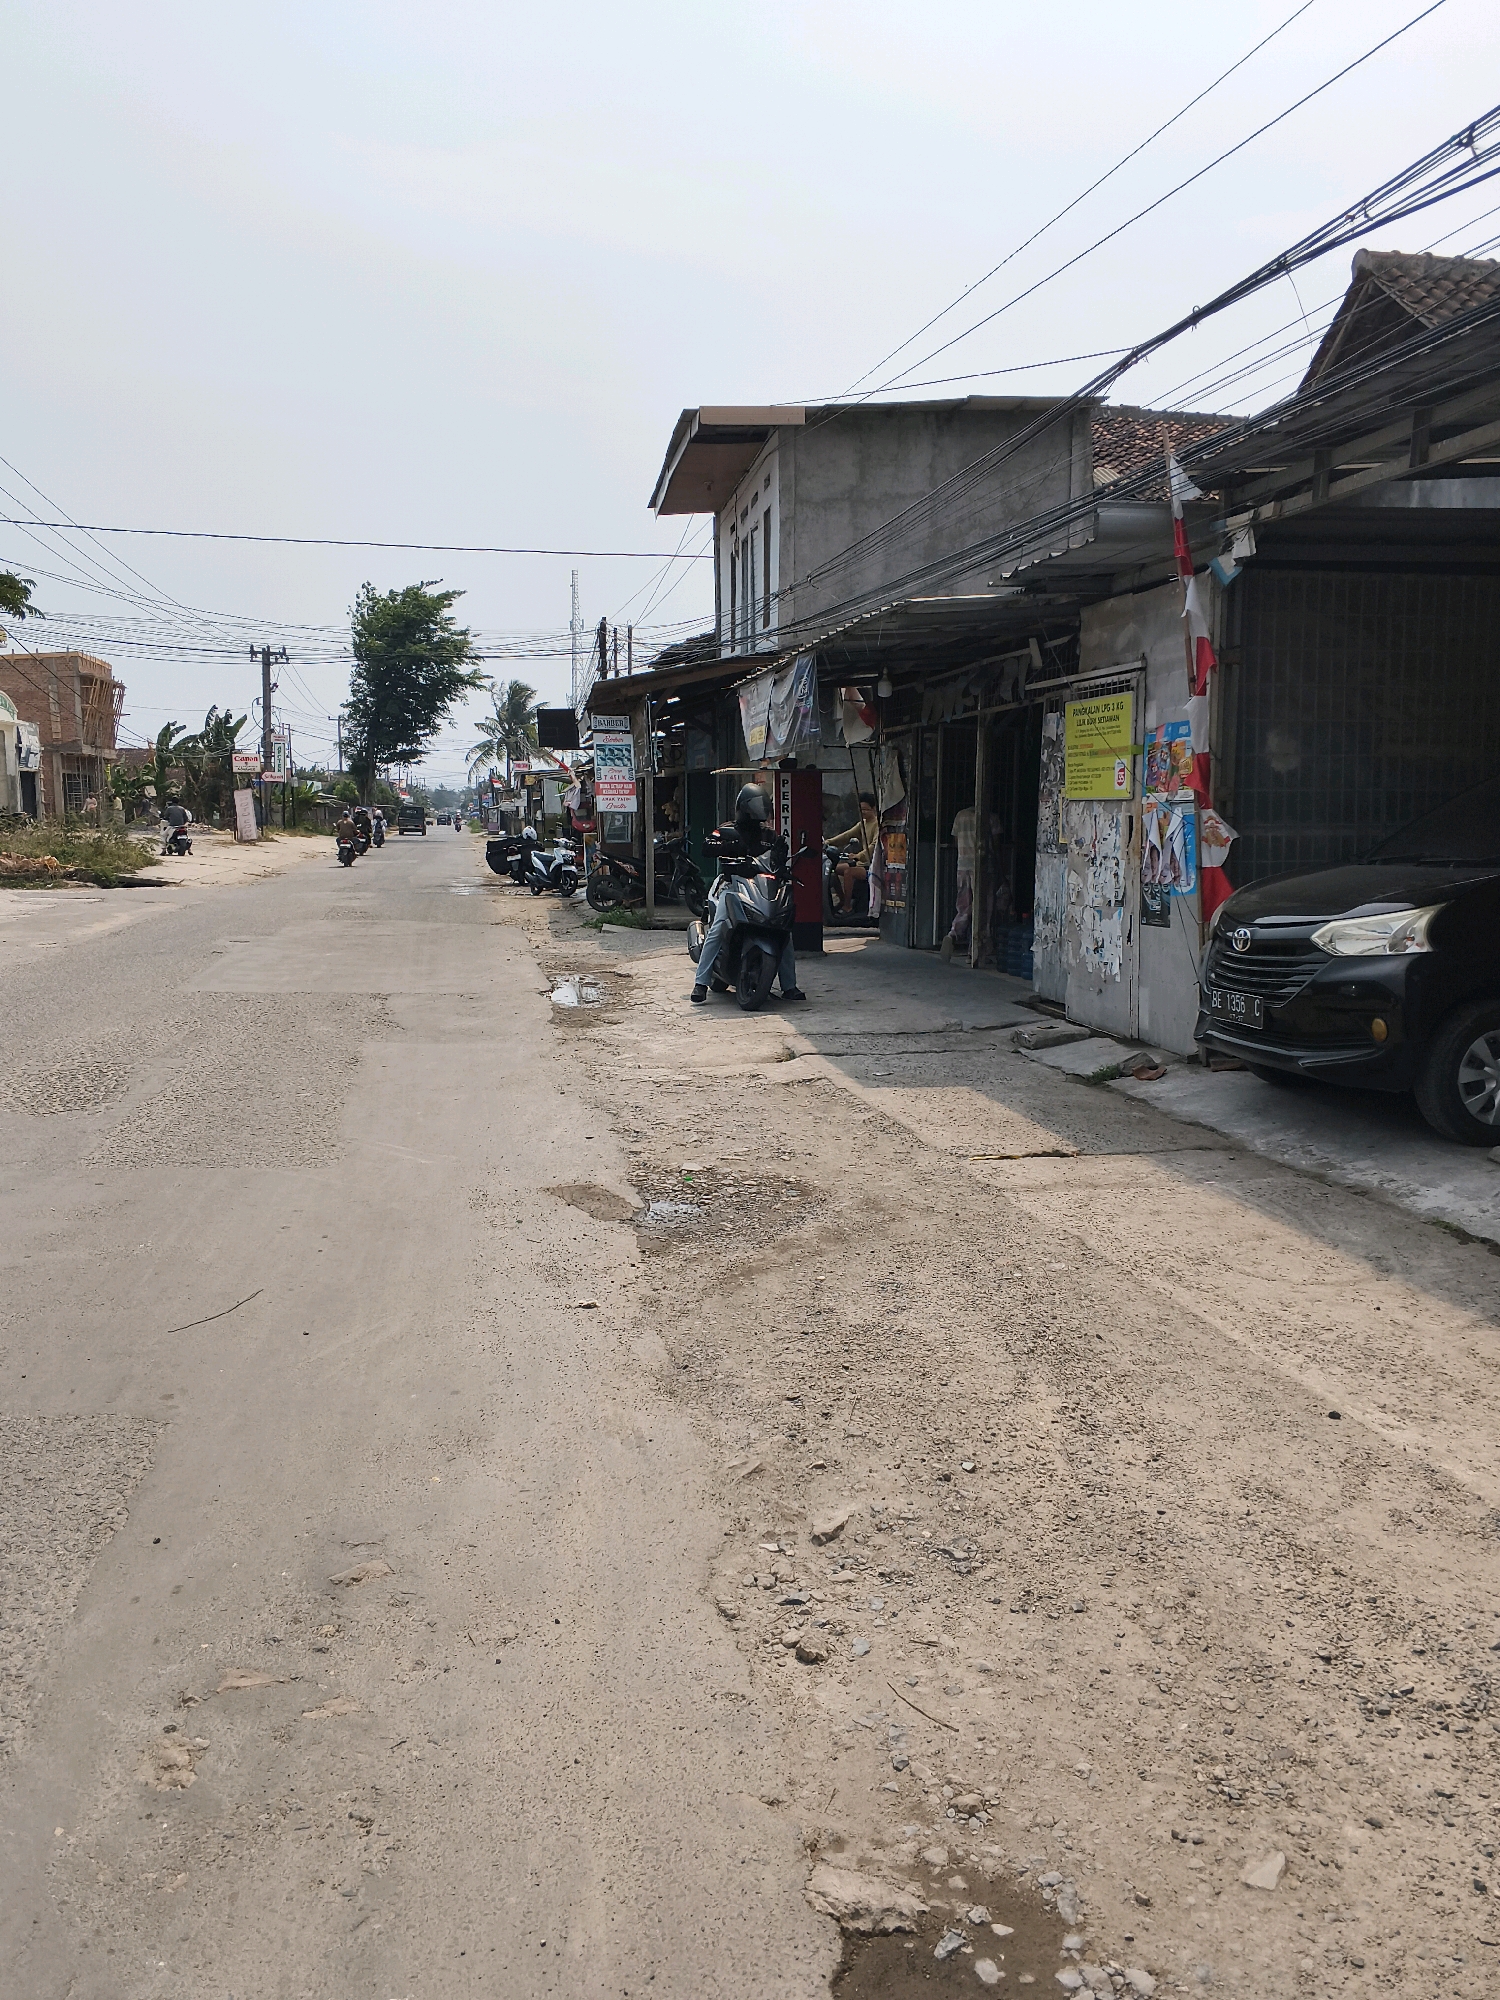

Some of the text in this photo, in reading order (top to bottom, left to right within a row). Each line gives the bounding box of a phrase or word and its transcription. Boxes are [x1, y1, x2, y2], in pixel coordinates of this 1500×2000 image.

[1073, 705, 1100, 717] PANGKALAN
[1101, 703, 1111, 713] LPG
[1116, 701, 1124, 711] KG
[597, 719, 624, 727] BARBER
[1211, 990, 1260, 1017] BE 1356 C
